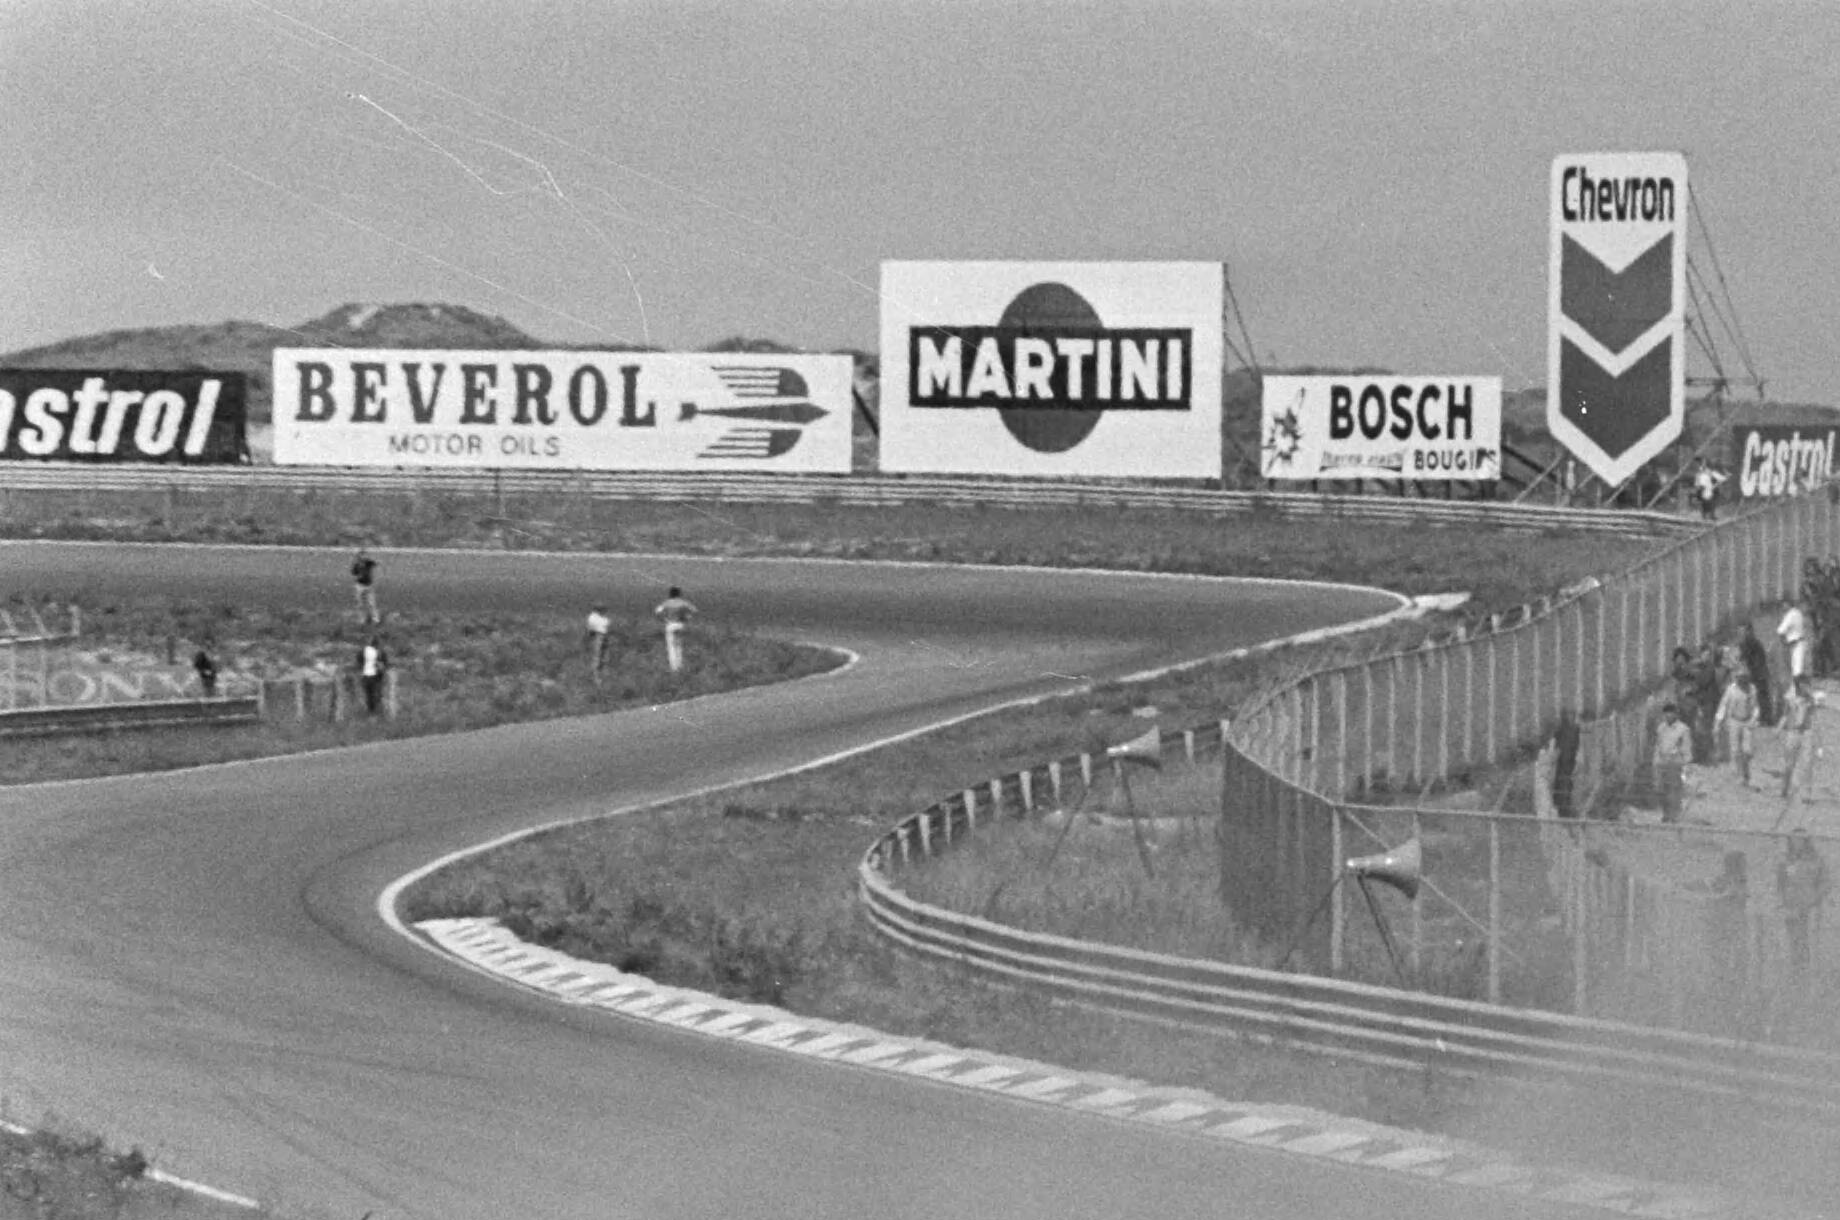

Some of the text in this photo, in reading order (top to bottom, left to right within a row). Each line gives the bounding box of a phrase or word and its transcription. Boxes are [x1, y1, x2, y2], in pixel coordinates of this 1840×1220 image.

[1562, 166, 1675, 222] Chevron
[295, 361, 656, 427] BEVEROL
[917, 335, 1183, 400] MARTINI
[1330, 384, 1472, 440] BOSCH
[389, 433, 561, 457] MOTOR OILS
[1740, 430, 1836, 497] Castrol
